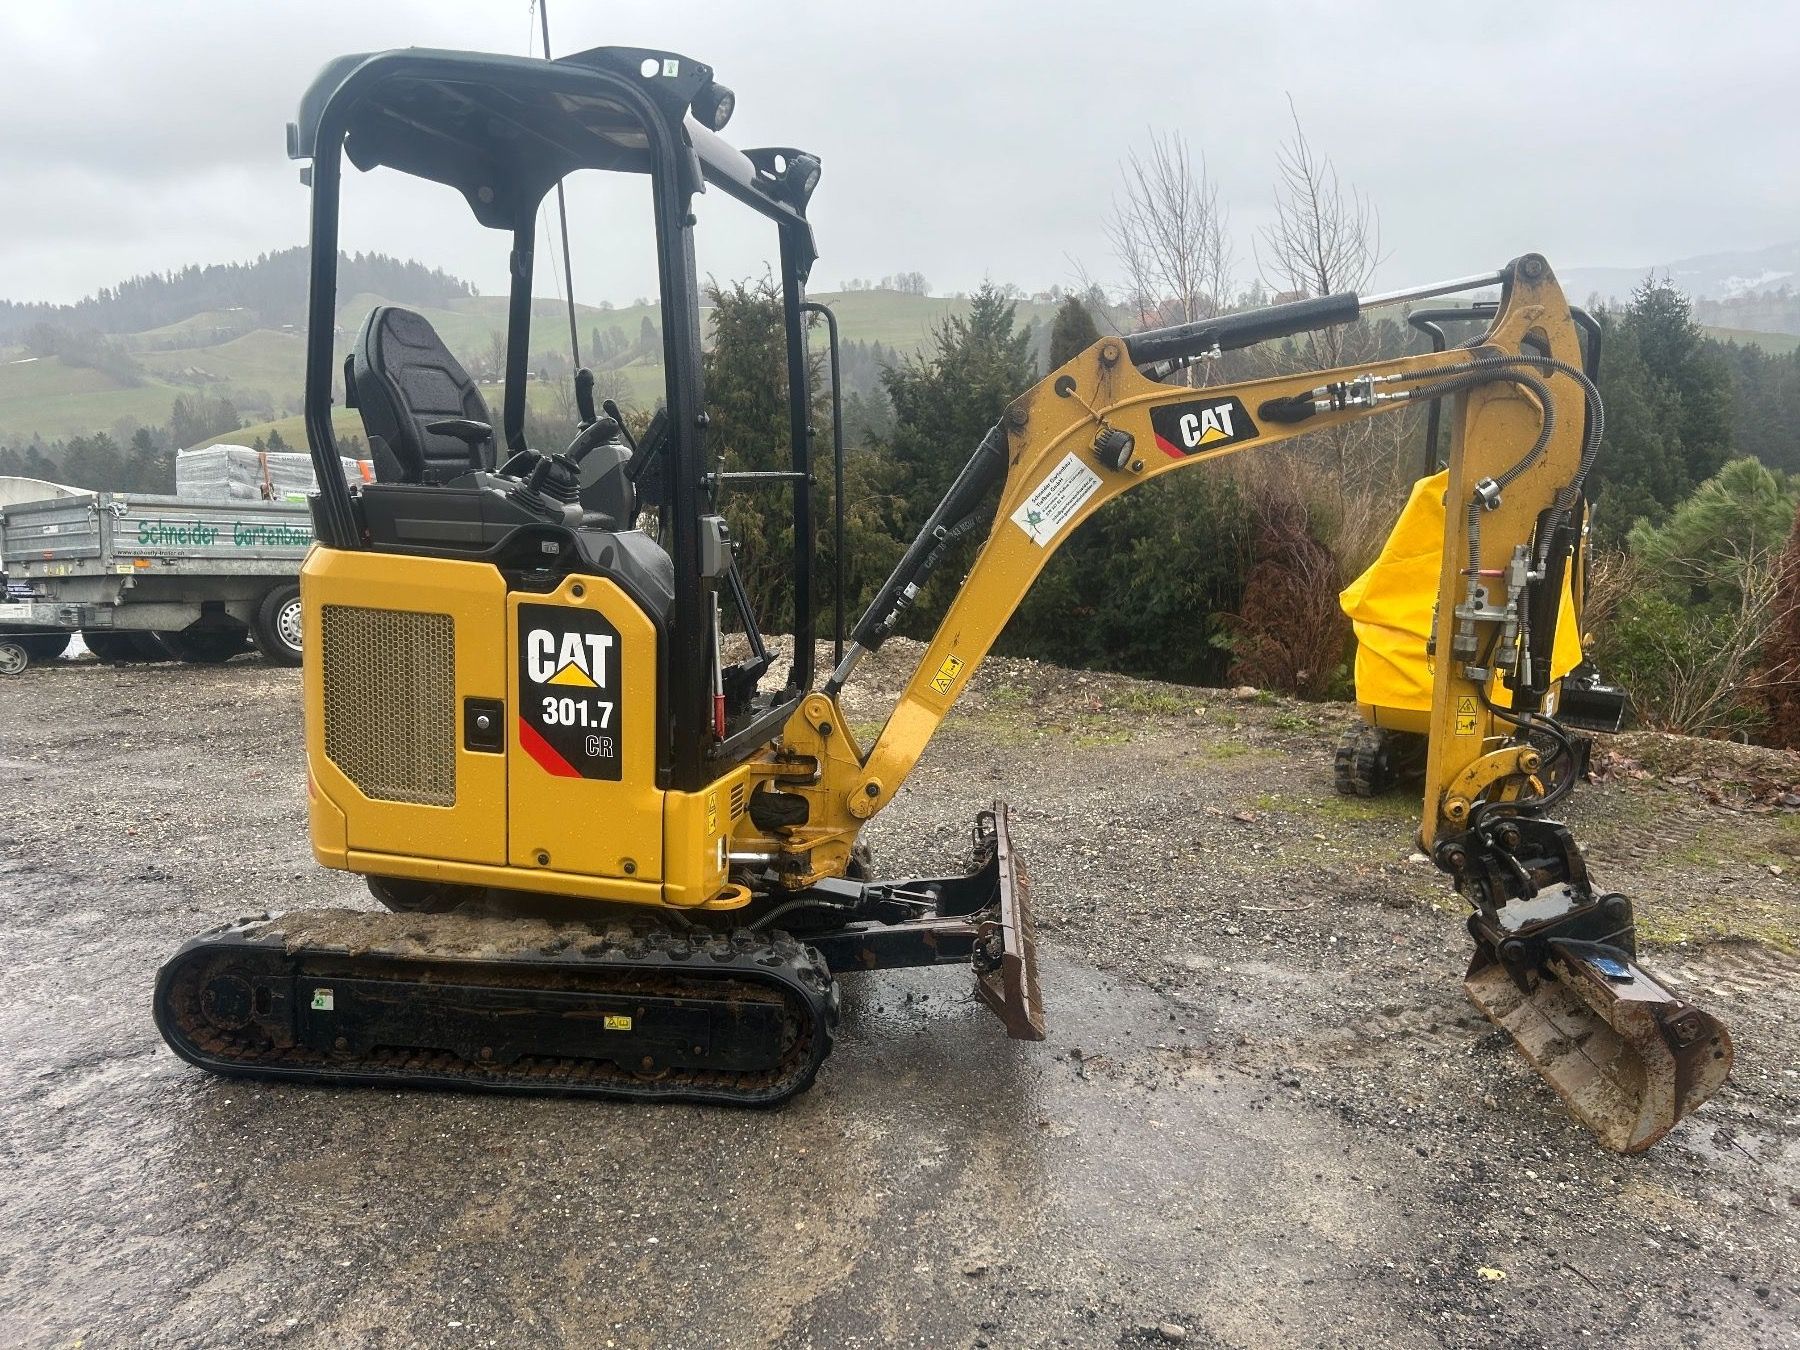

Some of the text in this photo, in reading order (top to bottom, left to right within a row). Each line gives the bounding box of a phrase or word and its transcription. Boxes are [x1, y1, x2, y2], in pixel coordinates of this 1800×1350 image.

[1179, 403, 1234, 448] CAT
[137, 519, 219, 545] Schneider
[527, 629, 613, 689] CAT
[542, 696, 614, 729] 301.7
[585, 735, 614, 758] CR
